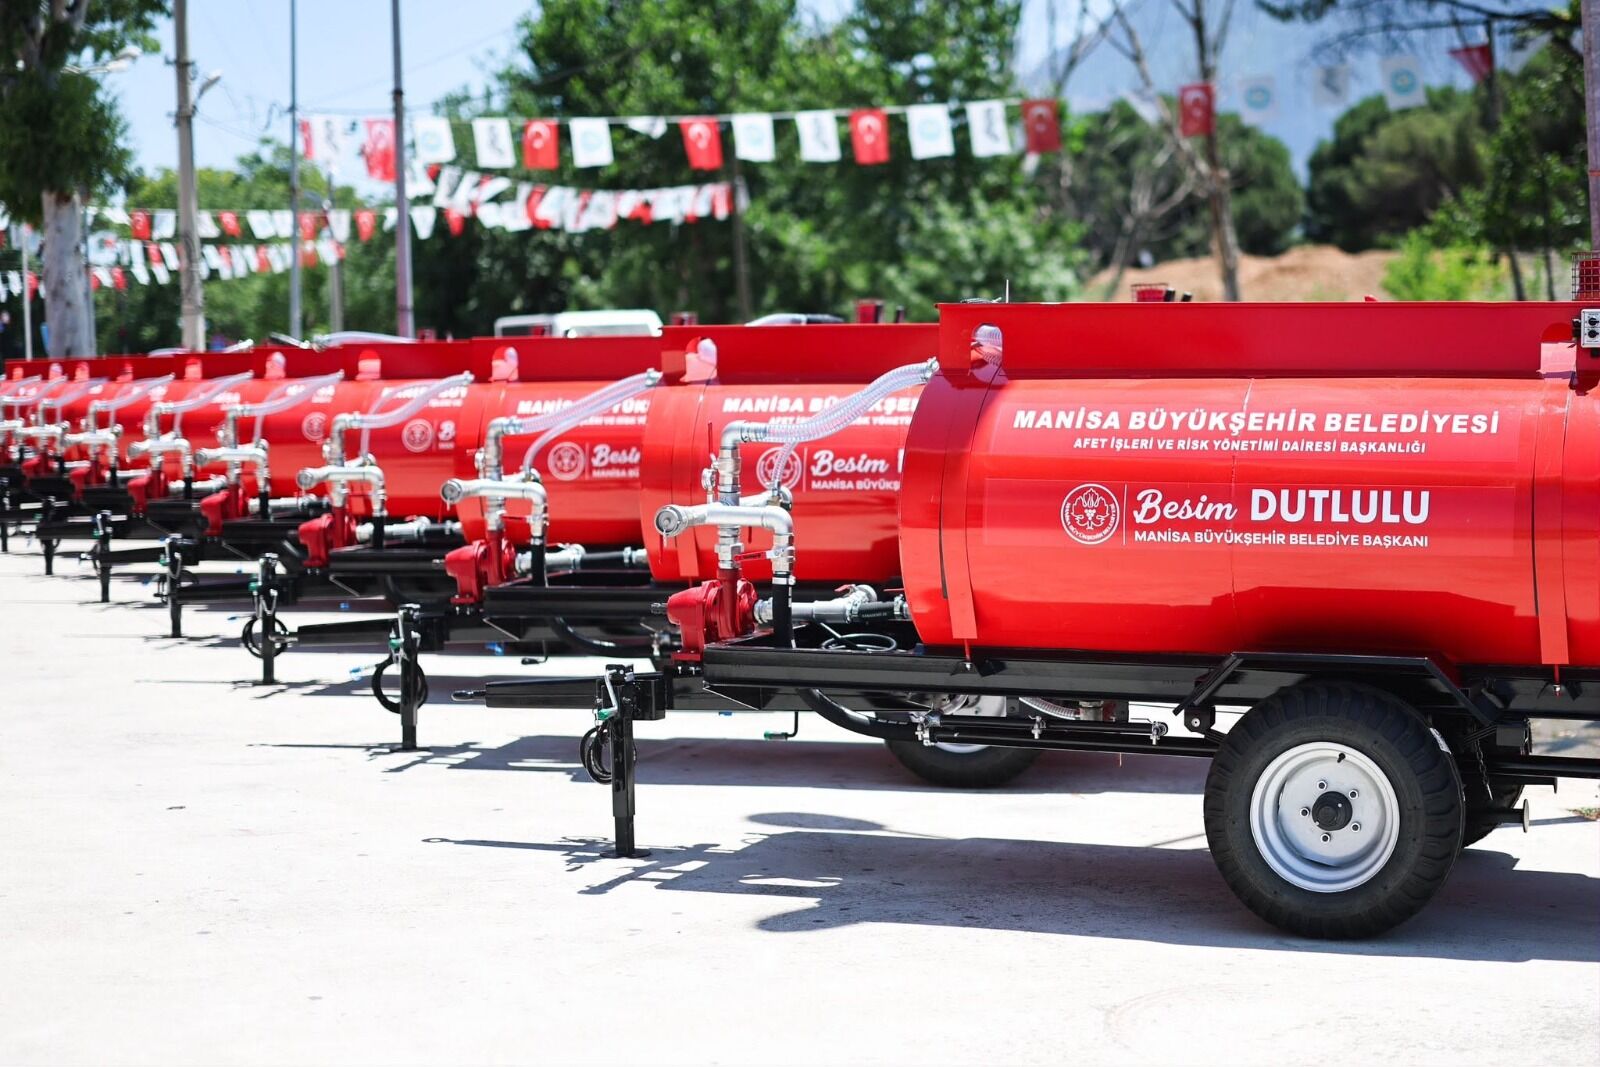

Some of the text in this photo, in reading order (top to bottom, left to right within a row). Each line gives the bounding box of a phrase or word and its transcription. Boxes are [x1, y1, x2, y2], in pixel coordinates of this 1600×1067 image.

[1013, 405, 1500, 436] MANİSA BÜYÜKŞEHİR BELEDİYESİ
[1073, 437, 1108, 450] AFET
[1110, 437, 1154, 453] İŞLERİ
[1157, 438, 1174, 450] VE
[1212, 437, 1279, 452] YÖNETİMİ
[1282, 438, 1337, 452] DAİRESİ
[1340, 439, 1426, 455] BAŞKANLIĞI
[810, 449, 890, 477] Besim
[811, 478, 854, 490] MANİSA
[1133, 488, 1237, 524] Besim
[1250, 489, 1430, 524] DUTLULU
[1134, 528, 1428, 549] MANİSA BÜYÜKŞEHİR BELEDİYE BAŞKANI
